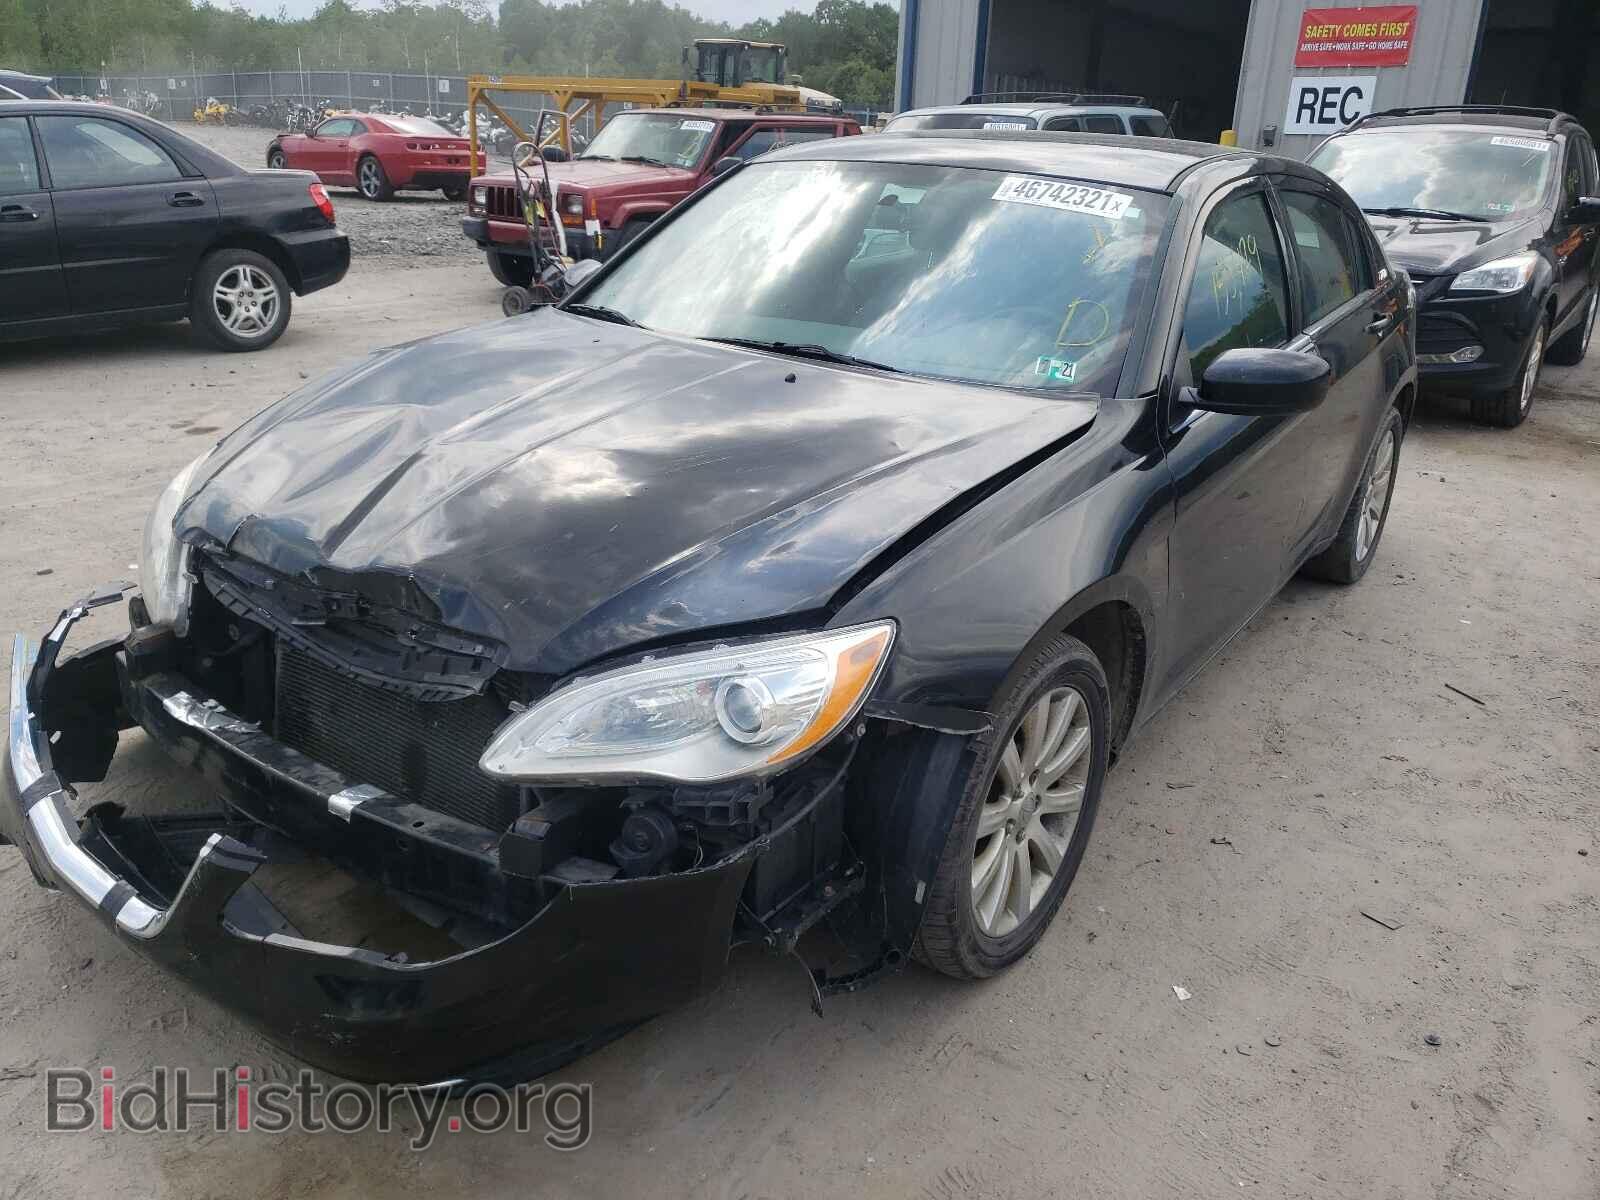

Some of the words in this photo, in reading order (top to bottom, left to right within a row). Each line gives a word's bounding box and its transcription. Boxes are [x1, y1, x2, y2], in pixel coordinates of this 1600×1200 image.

[1305, 24, 1342, 38] SAFETY
[1343, 23, 1378, 37] COMES
[1379, 22, 1410, 36] FIRST
[1368, 41, 1377, 50] GO
[1394, 40, 1409, 49] SAFE
[1295, 86, 1363, 125] REC
[1056, 299, 1109, 347] D
